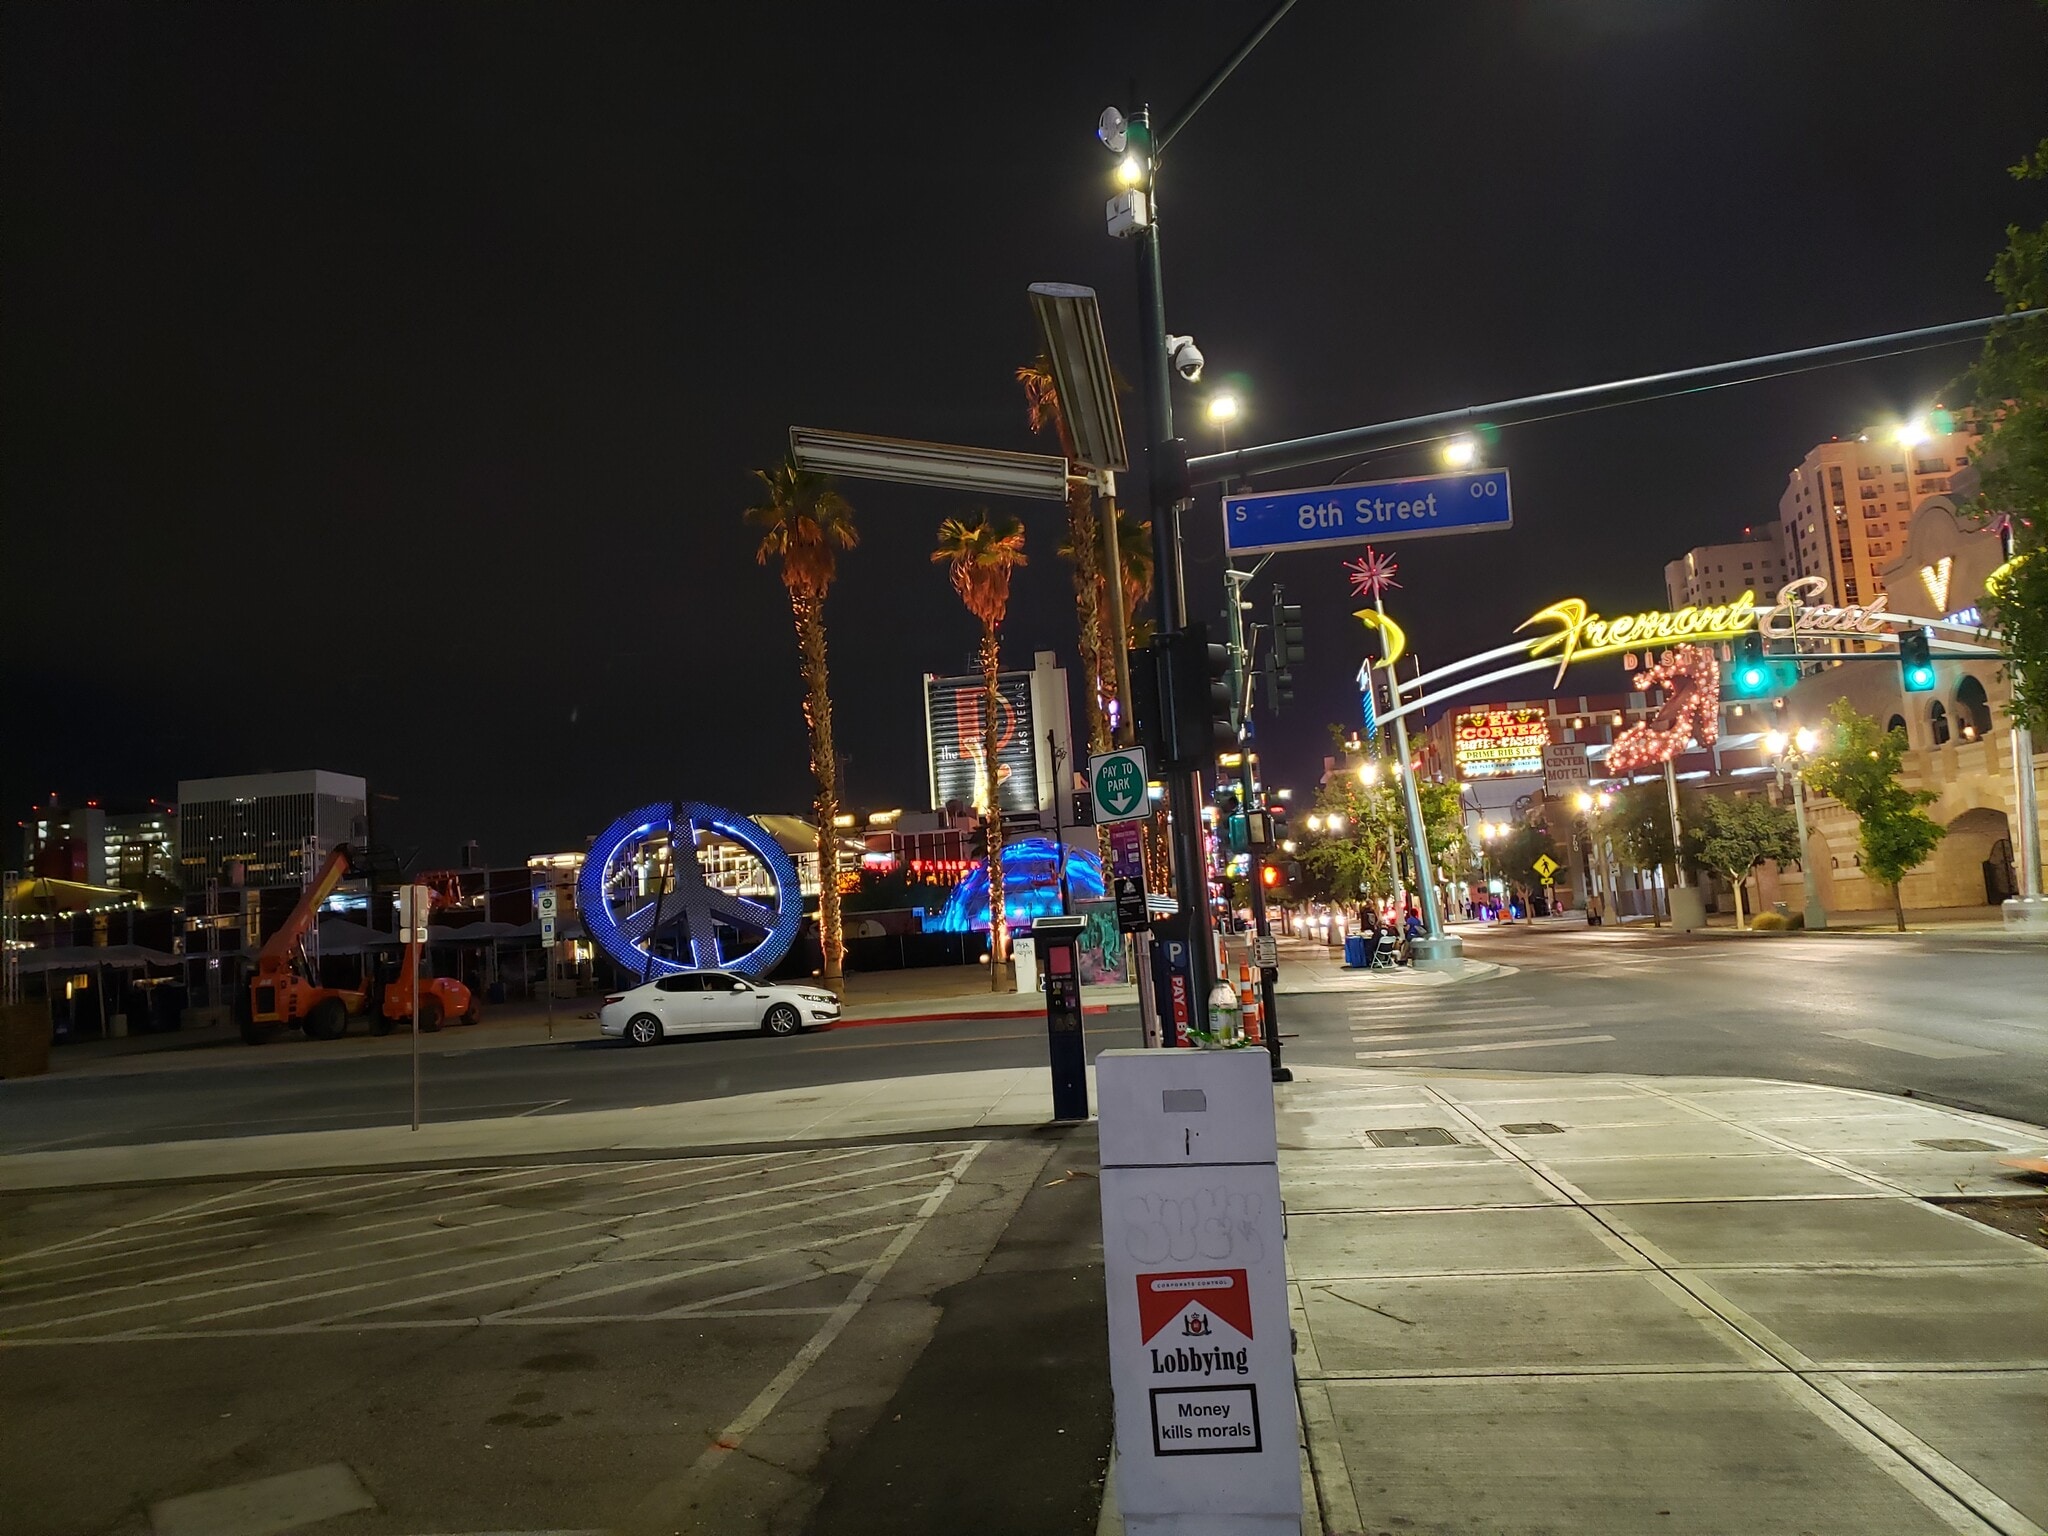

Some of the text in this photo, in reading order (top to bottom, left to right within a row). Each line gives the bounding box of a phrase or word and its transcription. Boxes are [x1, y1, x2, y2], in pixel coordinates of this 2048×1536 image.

[1235, 505, 1247, 522] S
[1298, 502, 1344, 530] 8th
[1355, 492, 1438, 524] Street
[1513, 576, 1888, 690] Fremont East
[1015, 682, 1029, 754] LAS VEGAS
[1489, 713, 1514, 726] EL
[1461, 723, 1542, 740] CORTEZ
[941, 745, 958, 760] the
[1466, 751, 1495, 759] PRIME
[1498, 749, 1514, 757] RIB
[1553, 746, 1575, 757] CITY
[1546, 756, 1585, 768] CENTER
[1102, 762, 1133, 779] PAY TO
[1547, 768, 1587, 781] MOTEL
[1107, 777, 1131, 793] PARK
[1169, 943, 1182, 963] P
[1172, 977, 1188, 1043] PAY BY
[1156, 1281, 1195, 1289] CORPORATE
[1150, 1346, 1249, 1376] Lobbying
[1178, 1403, 1231, 1419] Money
[1161, 1422, 1251, 1439] kills morals
